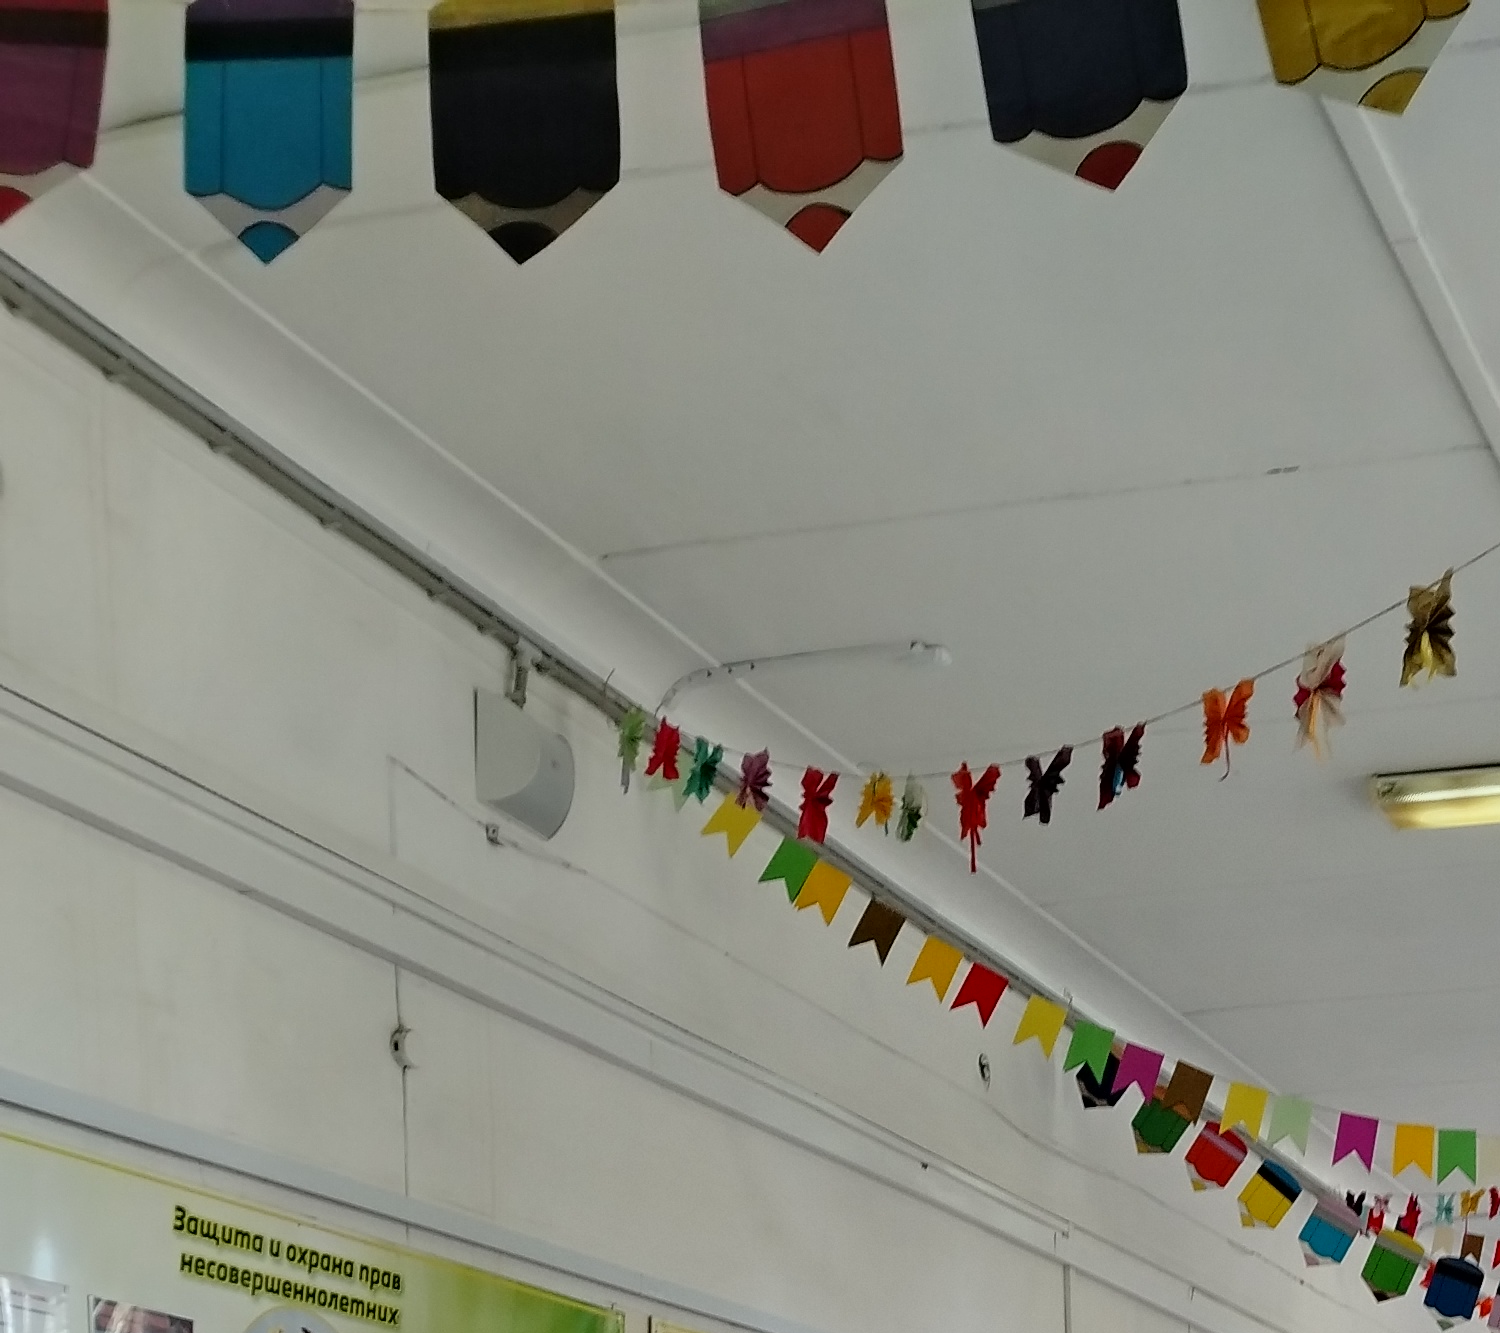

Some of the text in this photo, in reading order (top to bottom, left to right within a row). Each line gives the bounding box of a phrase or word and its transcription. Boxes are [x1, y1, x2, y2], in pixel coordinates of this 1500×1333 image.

[173, 1204, 402, 1291] Защита и охрана прав
[180, 1253, 400, 1326] несовершеннолетних
